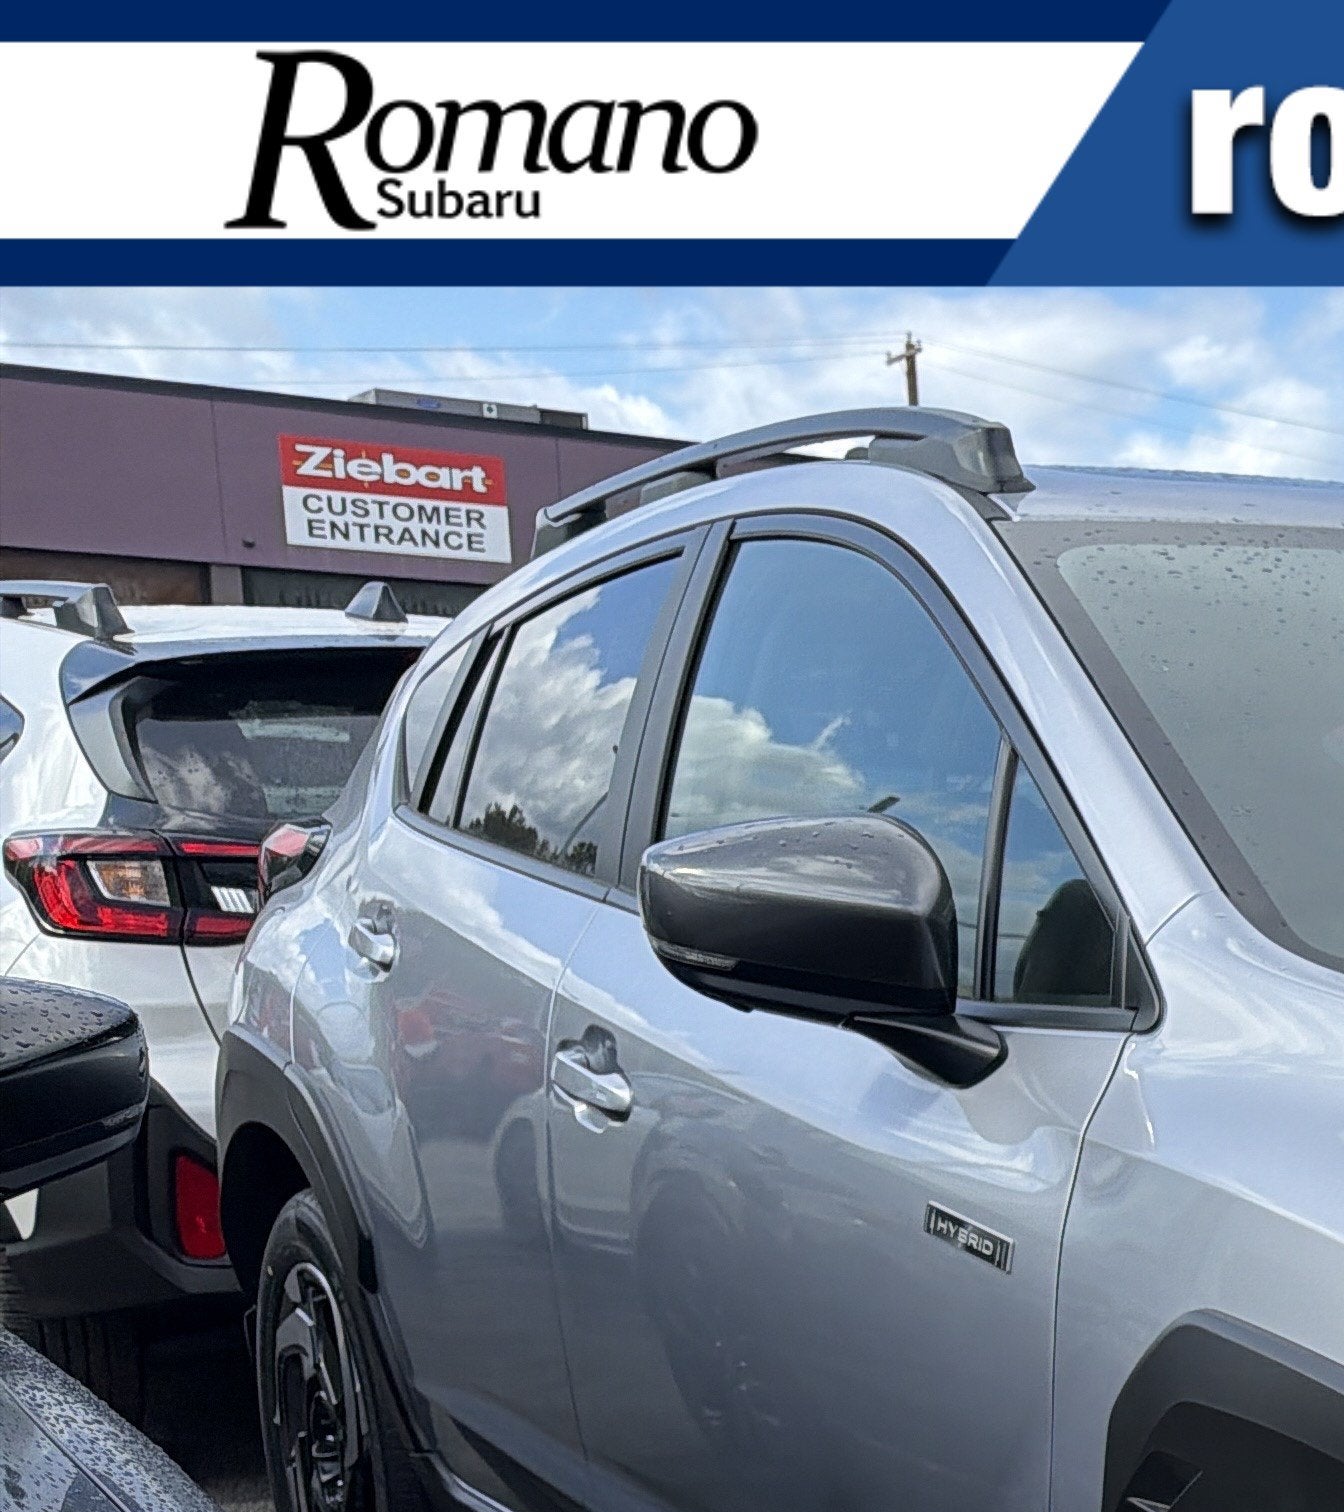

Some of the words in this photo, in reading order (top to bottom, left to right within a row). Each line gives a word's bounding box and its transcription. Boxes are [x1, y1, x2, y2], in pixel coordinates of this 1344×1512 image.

[294, 443, 488, 493] Ziebart
[302, 493, 486, 530] CUSTOMER
[307, 518, 486, 554] ENTRANCE
[935, 1216, 994, 1256] HYBRID
